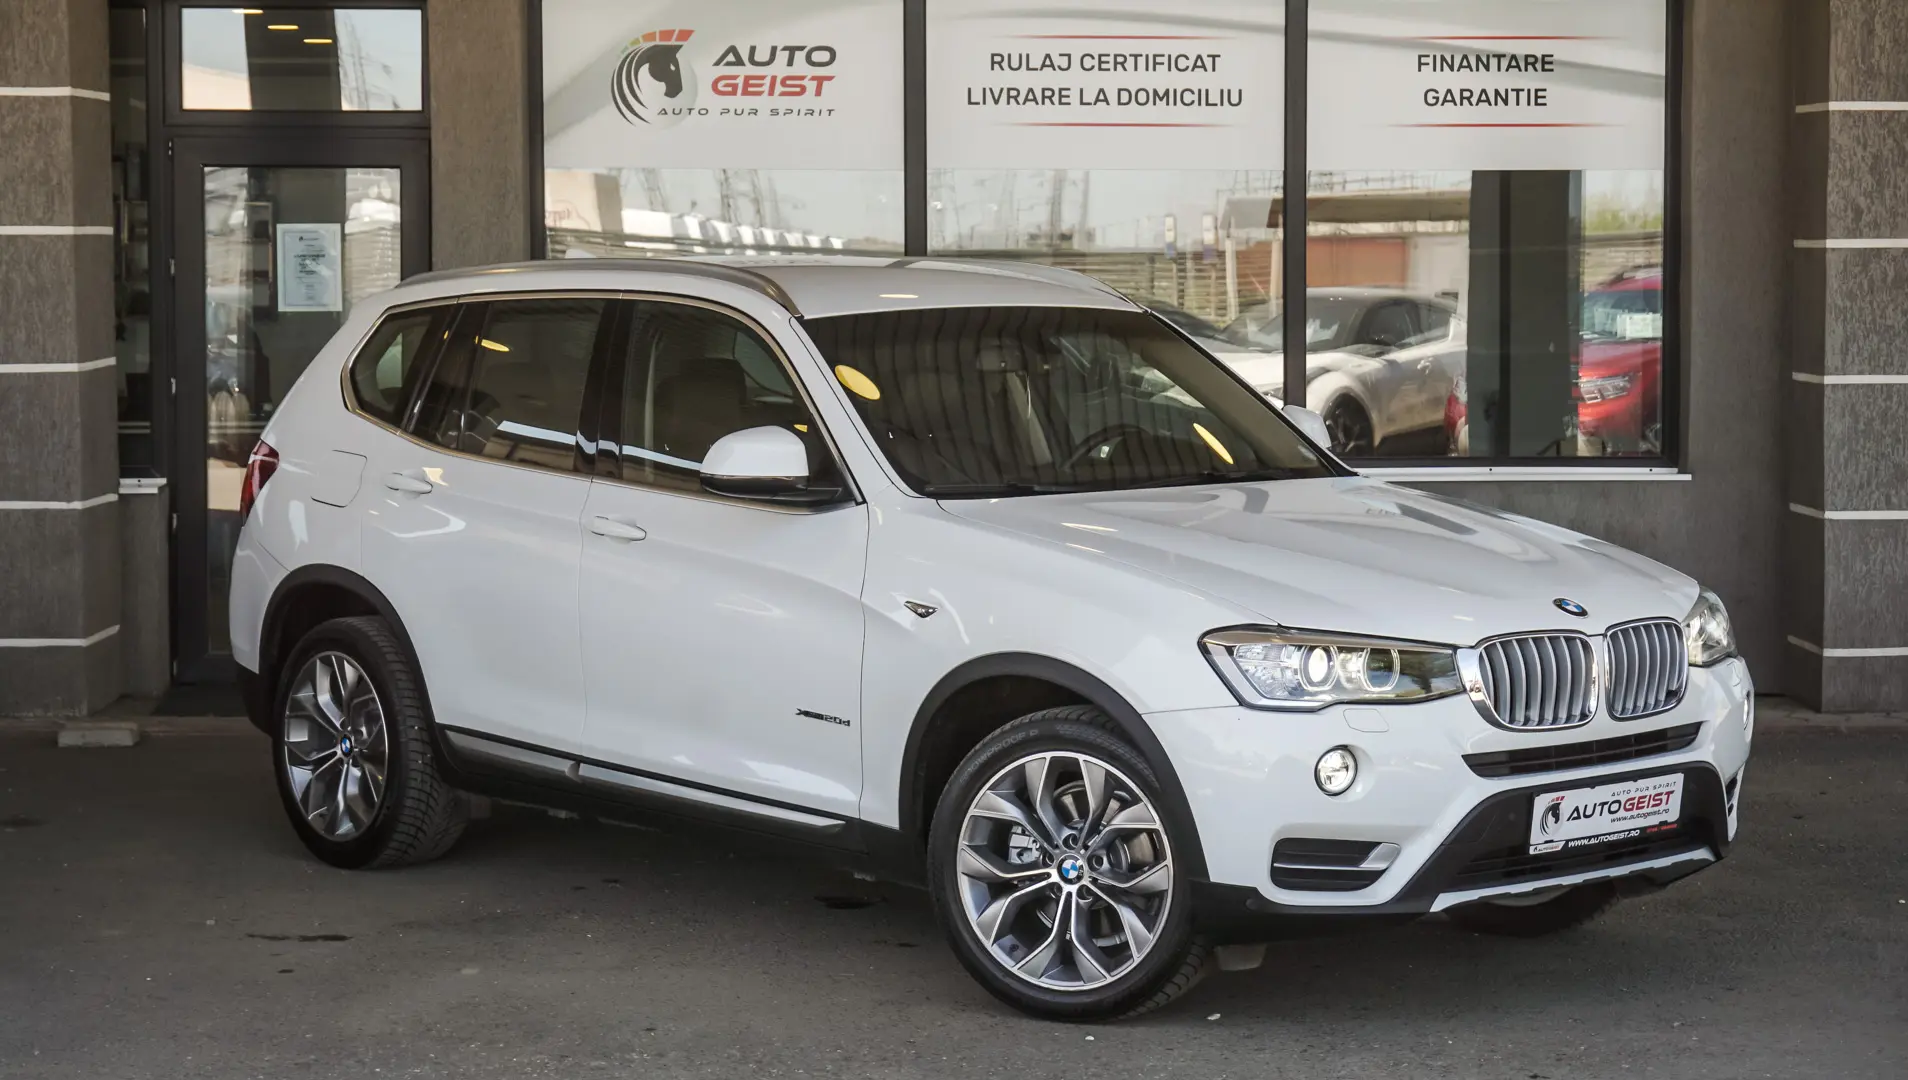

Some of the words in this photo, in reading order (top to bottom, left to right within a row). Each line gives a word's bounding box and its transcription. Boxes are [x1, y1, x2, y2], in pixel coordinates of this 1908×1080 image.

[712, 45, 837, 67] AUTO
[990, 53, 1071, 72] RULAJ
[1080, 53, 1221, 72] CERTIFICAT
[1417, 54, 1555, 72] FINANTARE
[711, 75, 836, 97] GEIST
[967, 87, 1072, 105] LIVRARE
[1079, 88, 1110, 106] LA
[1117, 88, 1243, 107] DOMICILIU
[1424, 88, 1548, 107] GARANTIE
[657, 107, 709, 116] AUTO
[719, 108, 759, 117] PUR
[769, 108, 836, 117] SPIRIT
[1610, 789, 1632, 797] AUTO
[1652, 781, 1677, 791] SPIRIT
[1568, 829, 1641, 848] WWW.AUTOGEIST.RO
